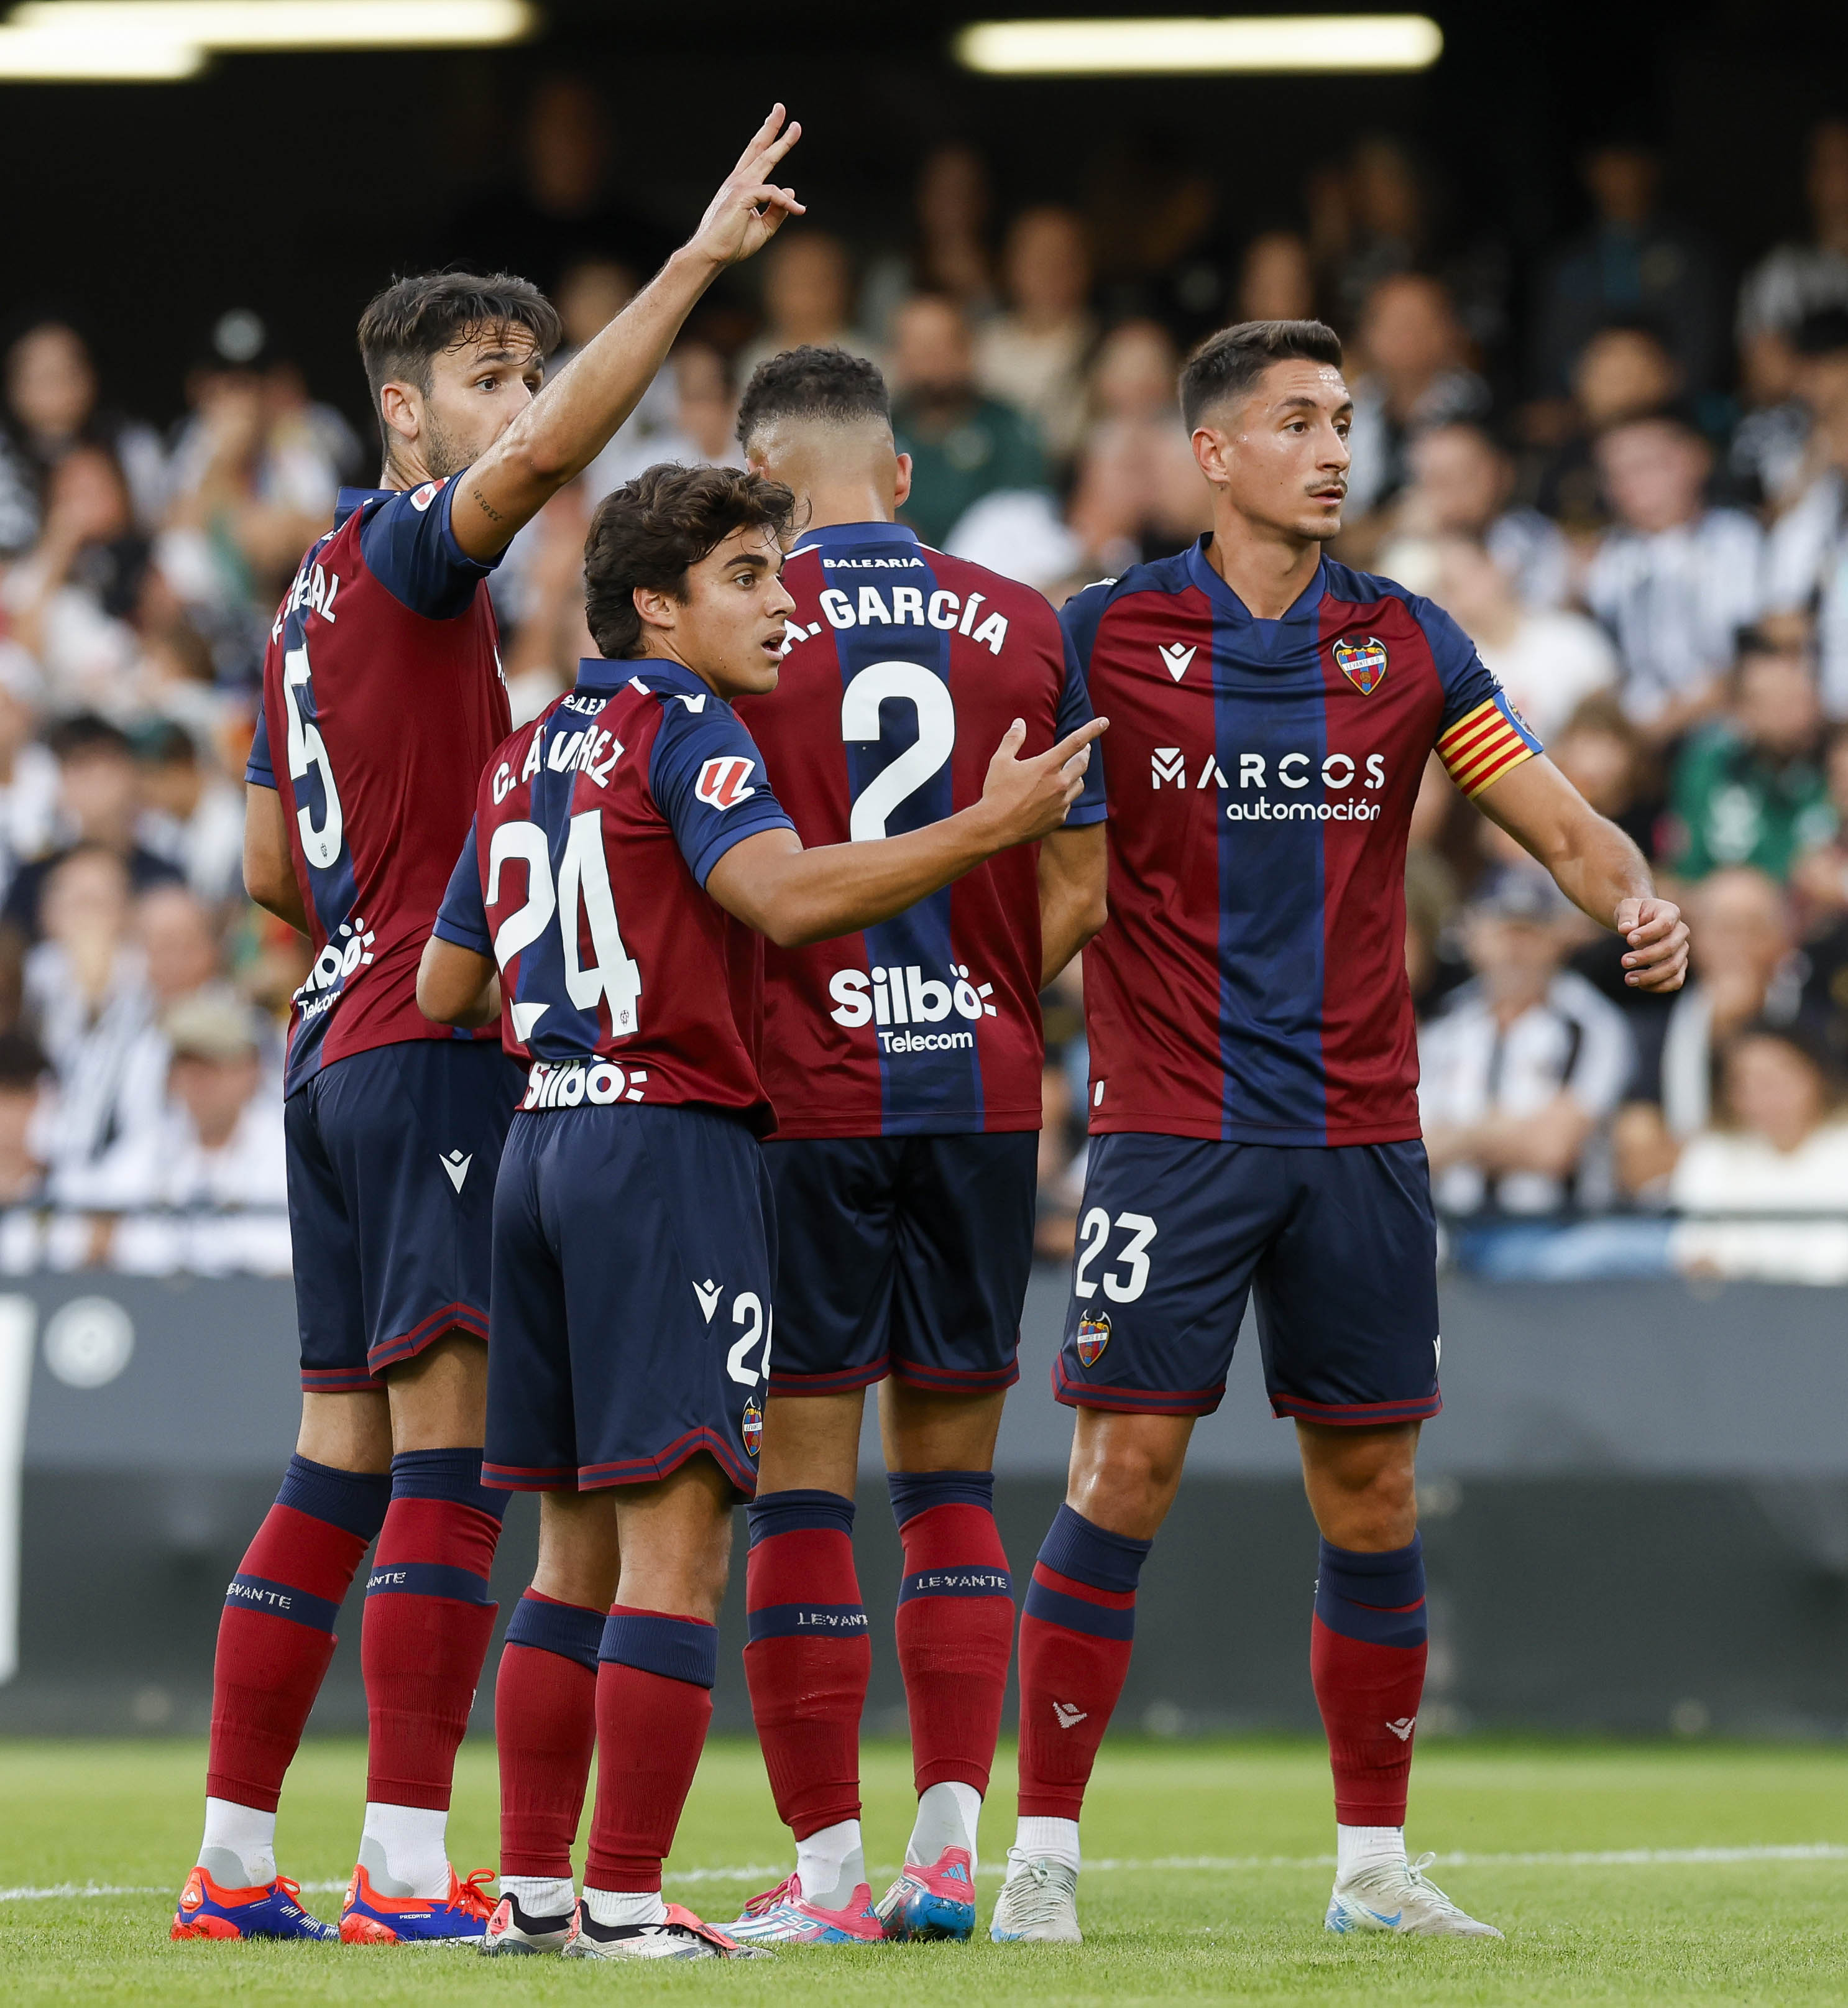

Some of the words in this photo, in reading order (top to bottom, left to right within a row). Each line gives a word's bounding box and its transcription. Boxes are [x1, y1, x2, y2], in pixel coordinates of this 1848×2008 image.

[823, 558, 924, 568] BALEARIA
[819, 587, 1009, 656] GARCÍA
[1346, 660, 1368, 670] LEVANTE
[283, 642, 342, 869] 5
[842, 661, 955, 842] 2
[1151, 748, 1385, 789] MARCOS
[492, 762, 517, 805] C.
[1226, 796, 1381, 821] automoción
[485, 808, 641, 1043] 24
[878, 1030, 973, 1053] Telecom
[1076, 1207, 1157, 1303] 23
[917, 1575, 1008, 1590] LEVANTE
[770, 1909, 818, 1932] F50
